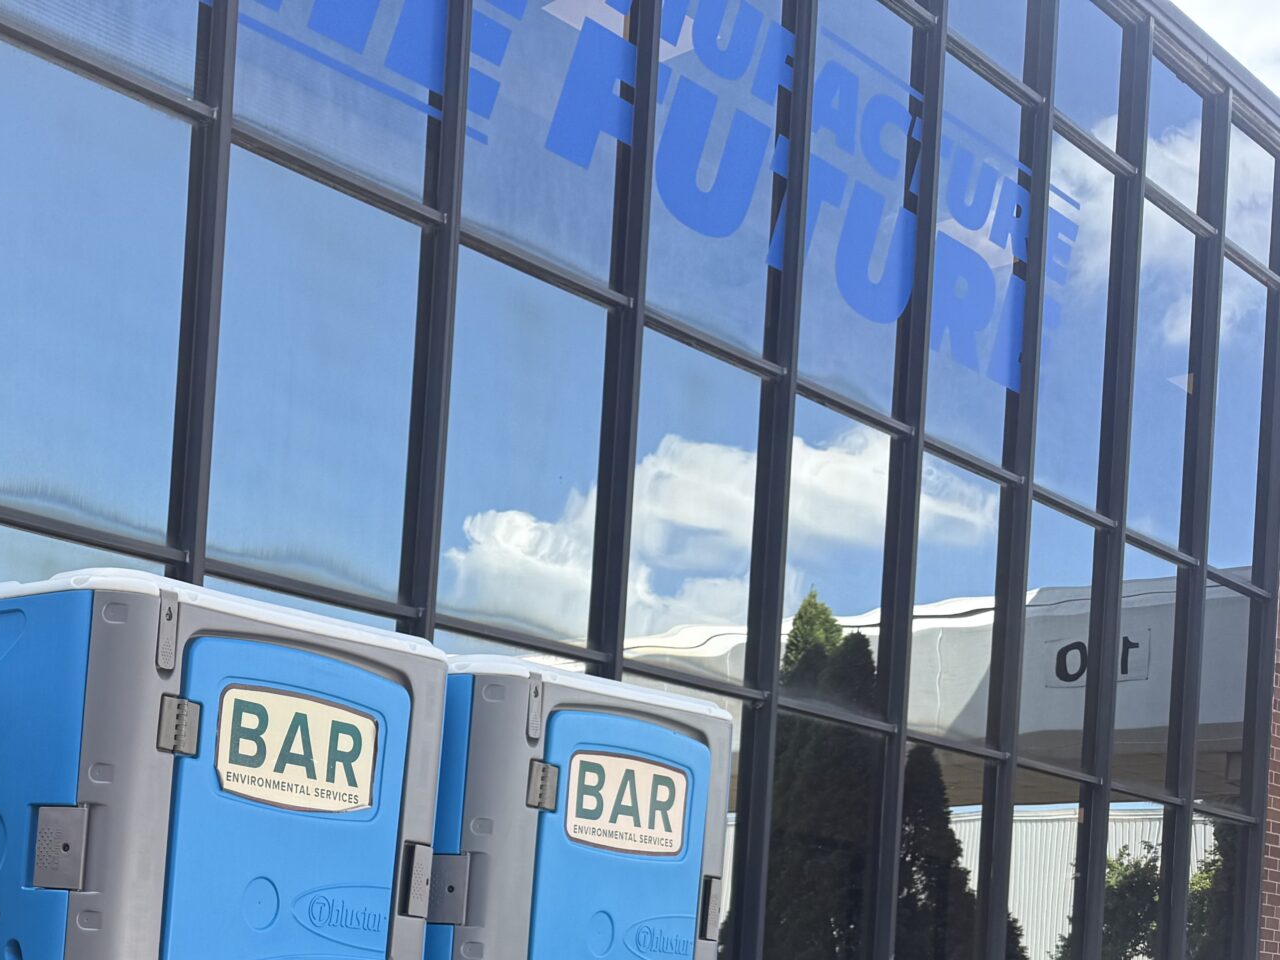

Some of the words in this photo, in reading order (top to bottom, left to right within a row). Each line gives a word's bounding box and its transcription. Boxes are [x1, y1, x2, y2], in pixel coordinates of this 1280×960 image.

[545, 16, 1062, 394] FUTURE
[228, 698, 363, 788] BAR
[226, 771, 311, 796] ENVIRONMENTAL
[314, 787, 359, 805] SERVICES
[575, 759, 676, 833] BAR
[573, 824, 637, 843] ENVIRONMENTAL
[639, 834, 673, 848] SERVICES
